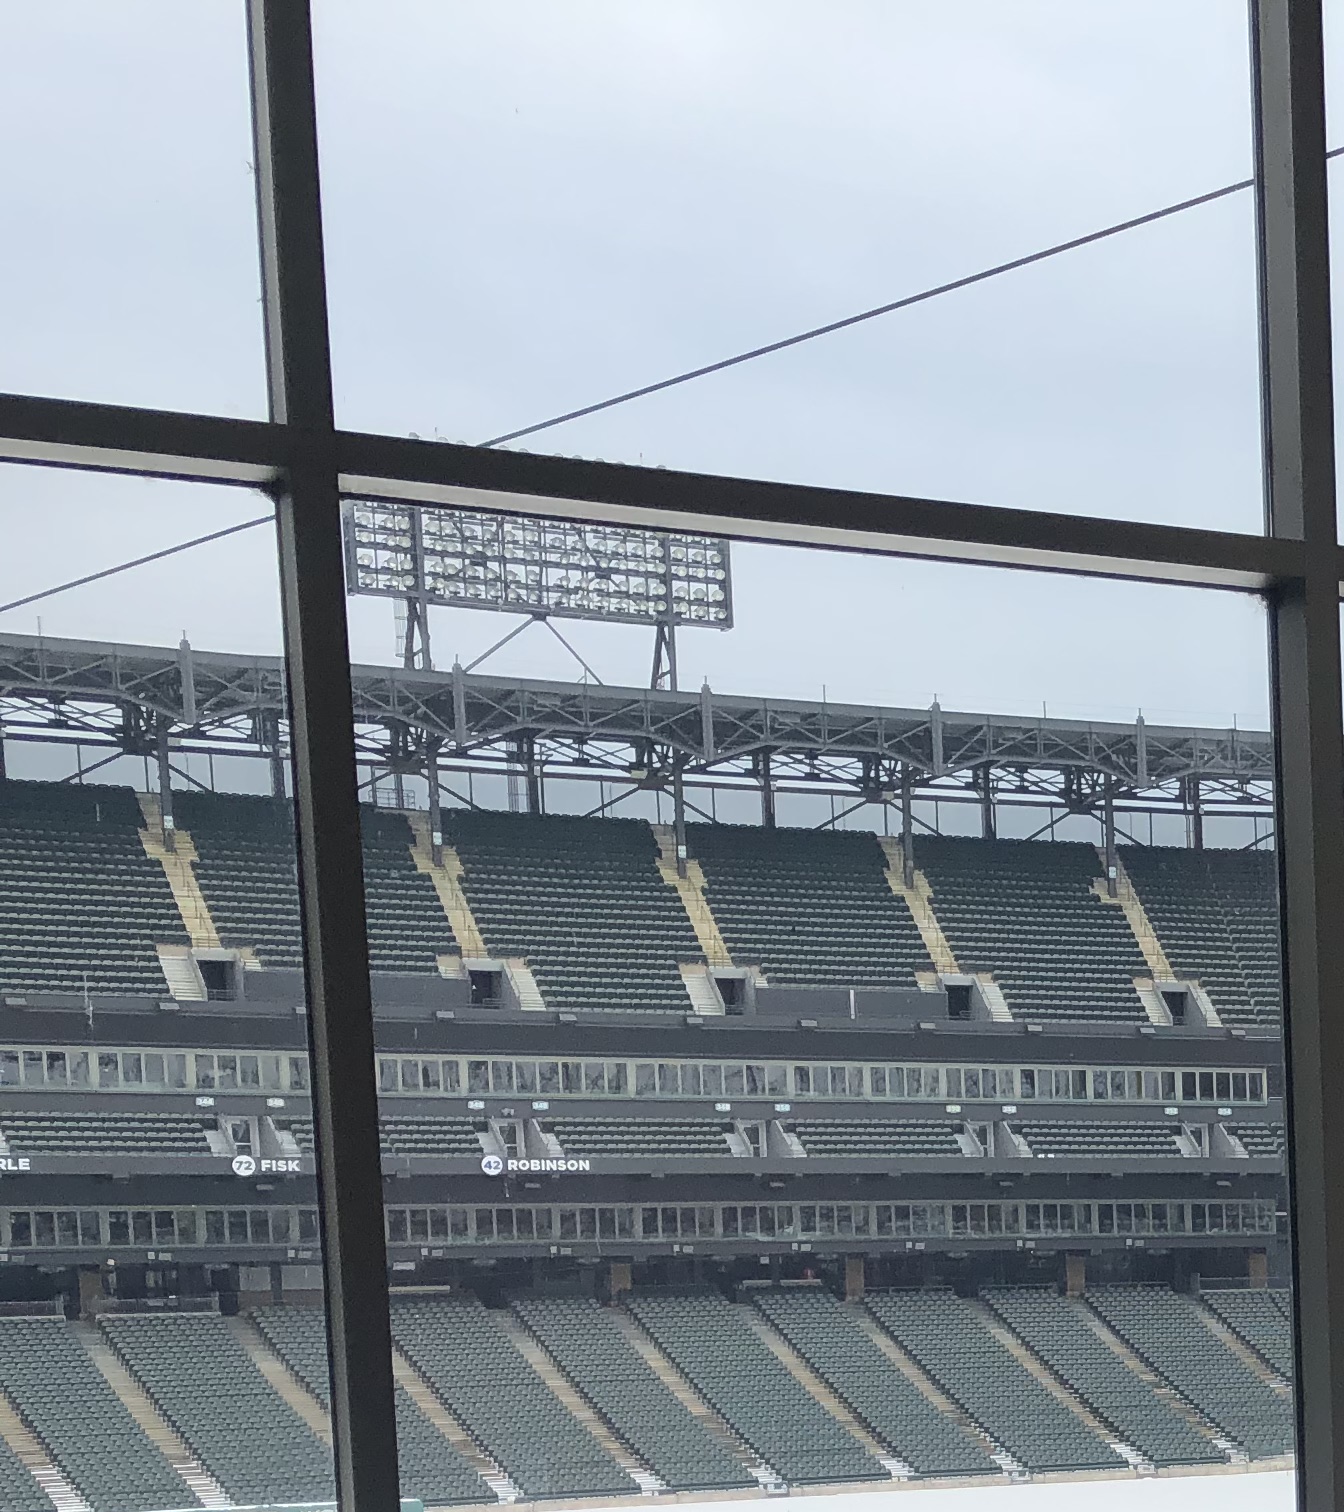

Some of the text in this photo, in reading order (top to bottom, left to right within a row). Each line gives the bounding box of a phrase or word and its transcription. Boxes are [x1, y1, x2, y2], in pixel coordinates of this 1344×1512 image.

[235, 1159, 301, 1171] 72 FISK
[483, 1159, 590, 1171] 42 ROBINSON
